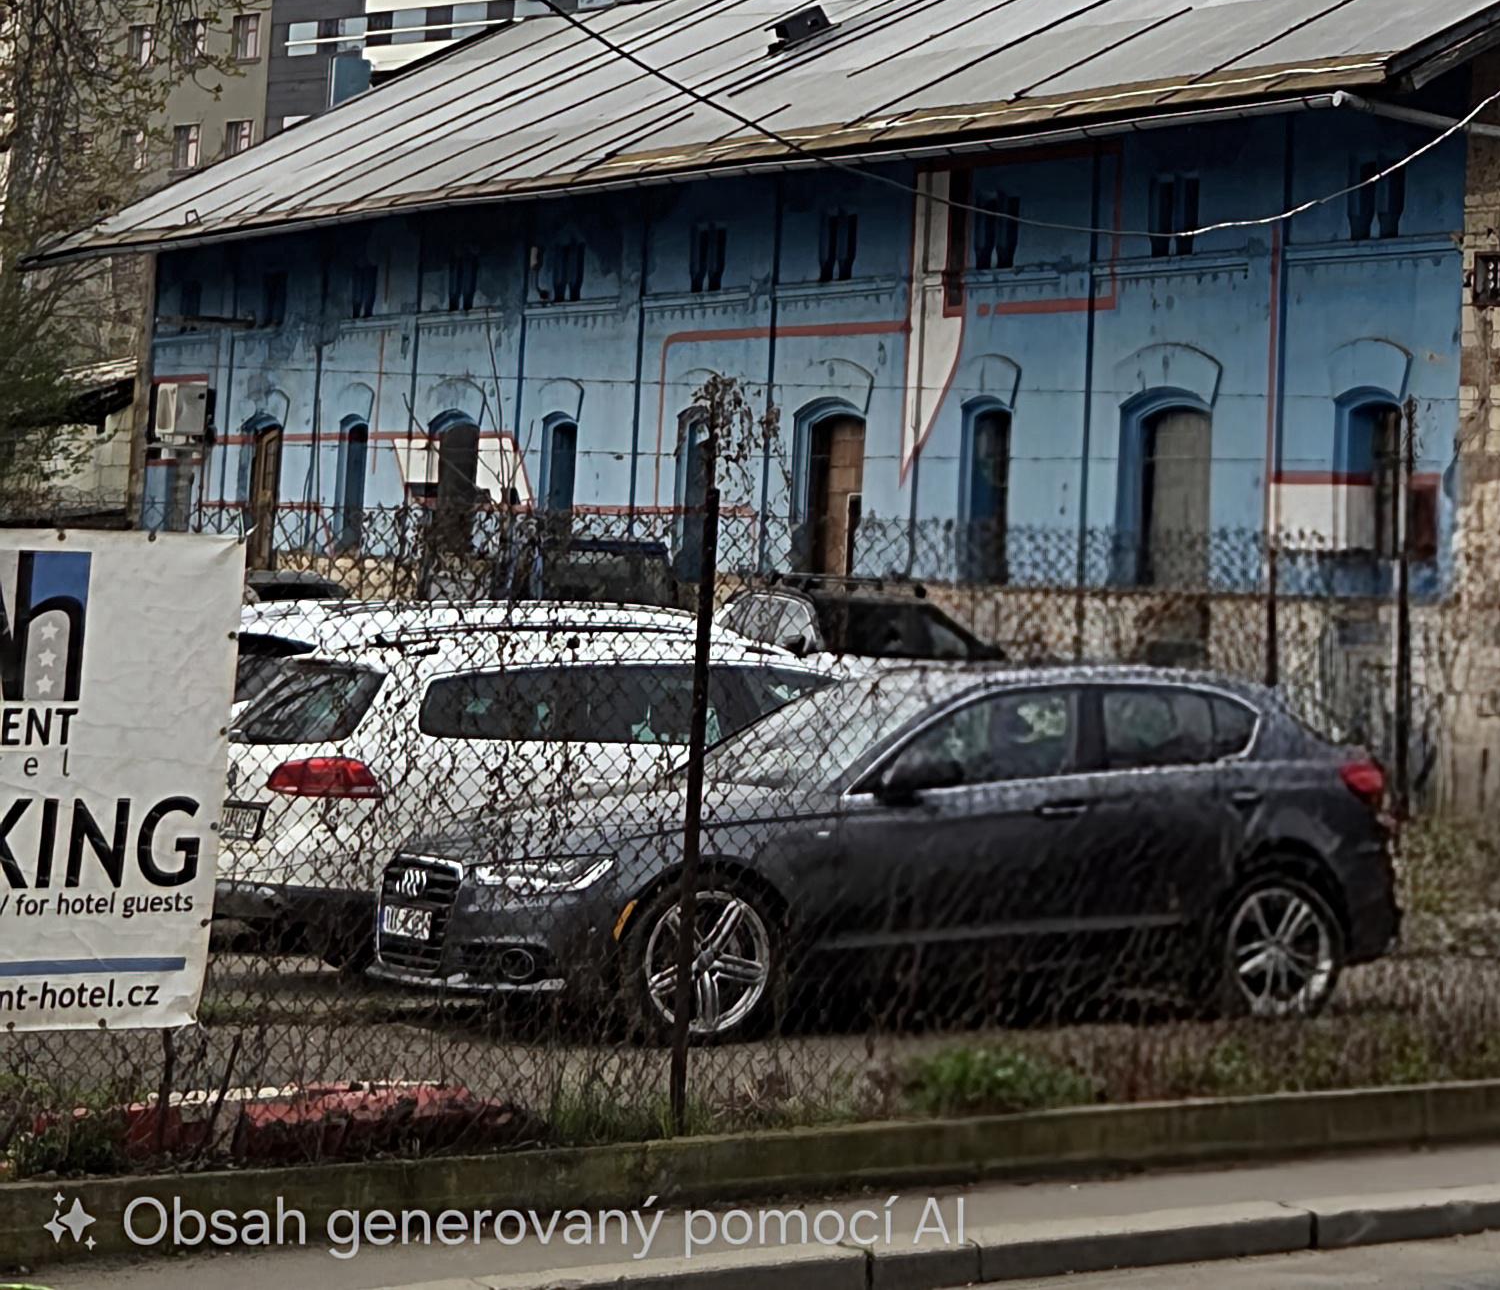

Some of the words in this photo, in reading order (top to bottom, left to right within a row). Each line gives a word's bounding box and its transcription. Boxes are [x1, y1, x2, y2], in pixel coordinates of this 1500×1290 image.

[16, 893, 50, 916] for
[57, 891, 116, 915] hotel
[122, 891, 194, 919] guests
